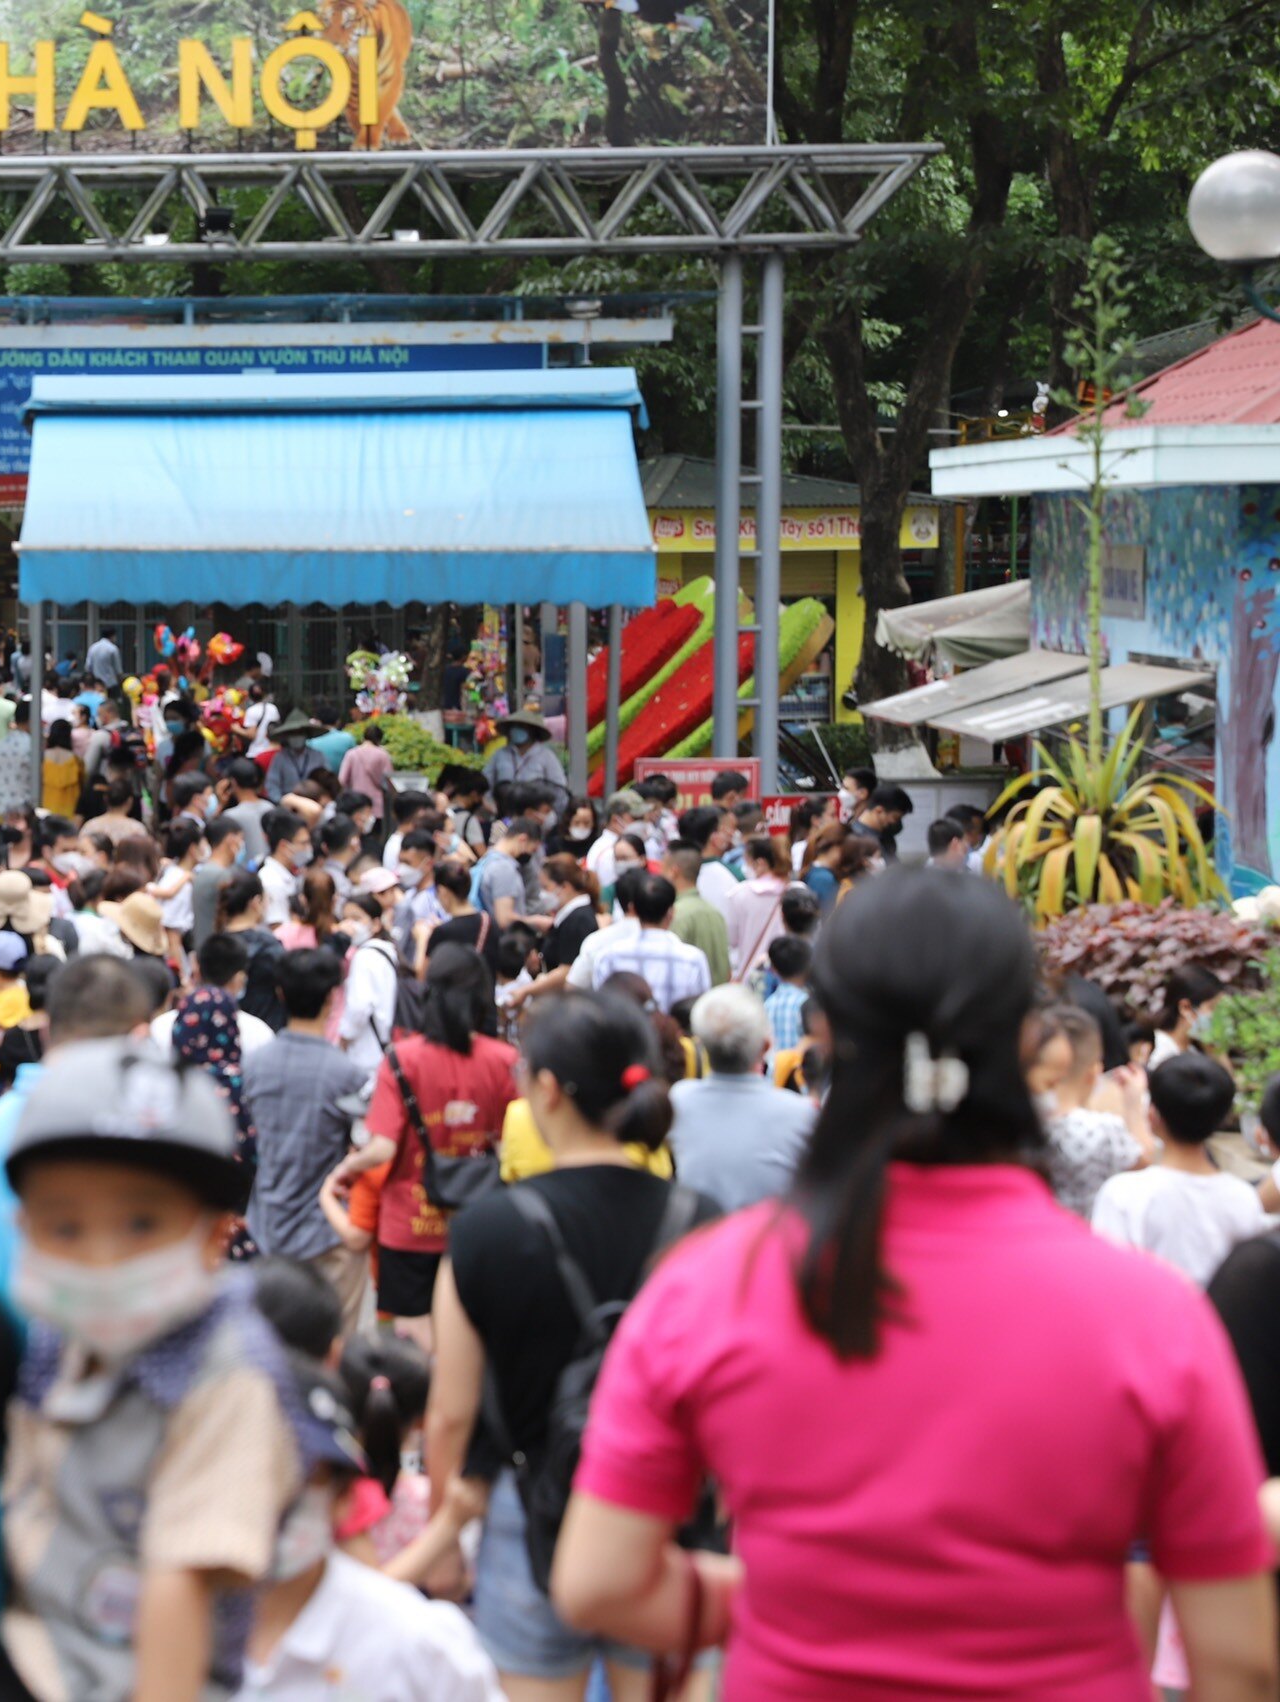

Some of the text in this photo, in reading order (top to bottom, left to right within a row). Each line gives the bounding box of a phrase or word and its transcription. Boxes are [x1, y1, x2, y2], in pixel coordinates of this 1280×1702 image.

[178, 10, 377, 149] NỘI
[48, 347, 85, 367] DẪN
[89, 348, 147, 367] KHÁCH
[152, 350, 200, 366] THAM
[204, 350, 254, 366] QUAN
[258, 347, 308, 365] VƯỜN
[350, 347, 375, 364] HÀ
[378, 347, 409, 368] NỘI
[808, 515, 825, 536] số
[828, 518, 834, 535] 1
[765, 798, 792, 827] CẤM
